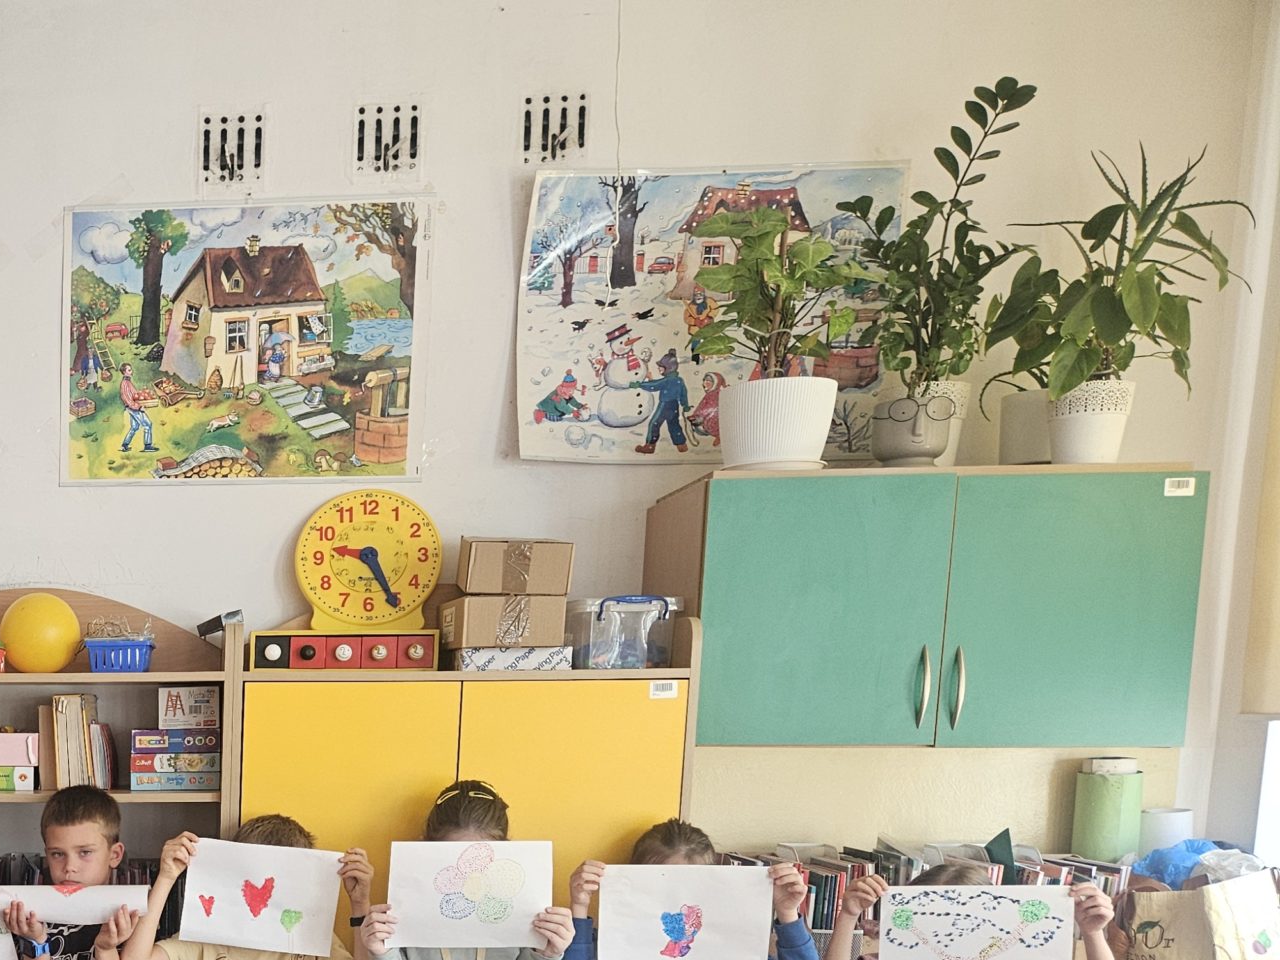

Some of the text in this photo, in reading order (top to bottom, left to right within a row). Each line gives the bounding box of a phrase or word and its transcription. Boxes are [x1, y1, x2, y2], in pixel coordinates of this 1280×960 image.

[336, 506, 353, 523] 11
[360, 500, 379, 515] 12
[391, 506, 400, 521] 1
[316, 526, 336, 541] 10
[410, 523, 421, 538] 2
[313, 550, 325, 566] 9
[417, 547, 429, 563] 3
[320, 575, 332, 591] 8
[408, 574, 420, 589] 4
[339, 592, 351, 608] 7
[363, 597, 375, 613] 6
